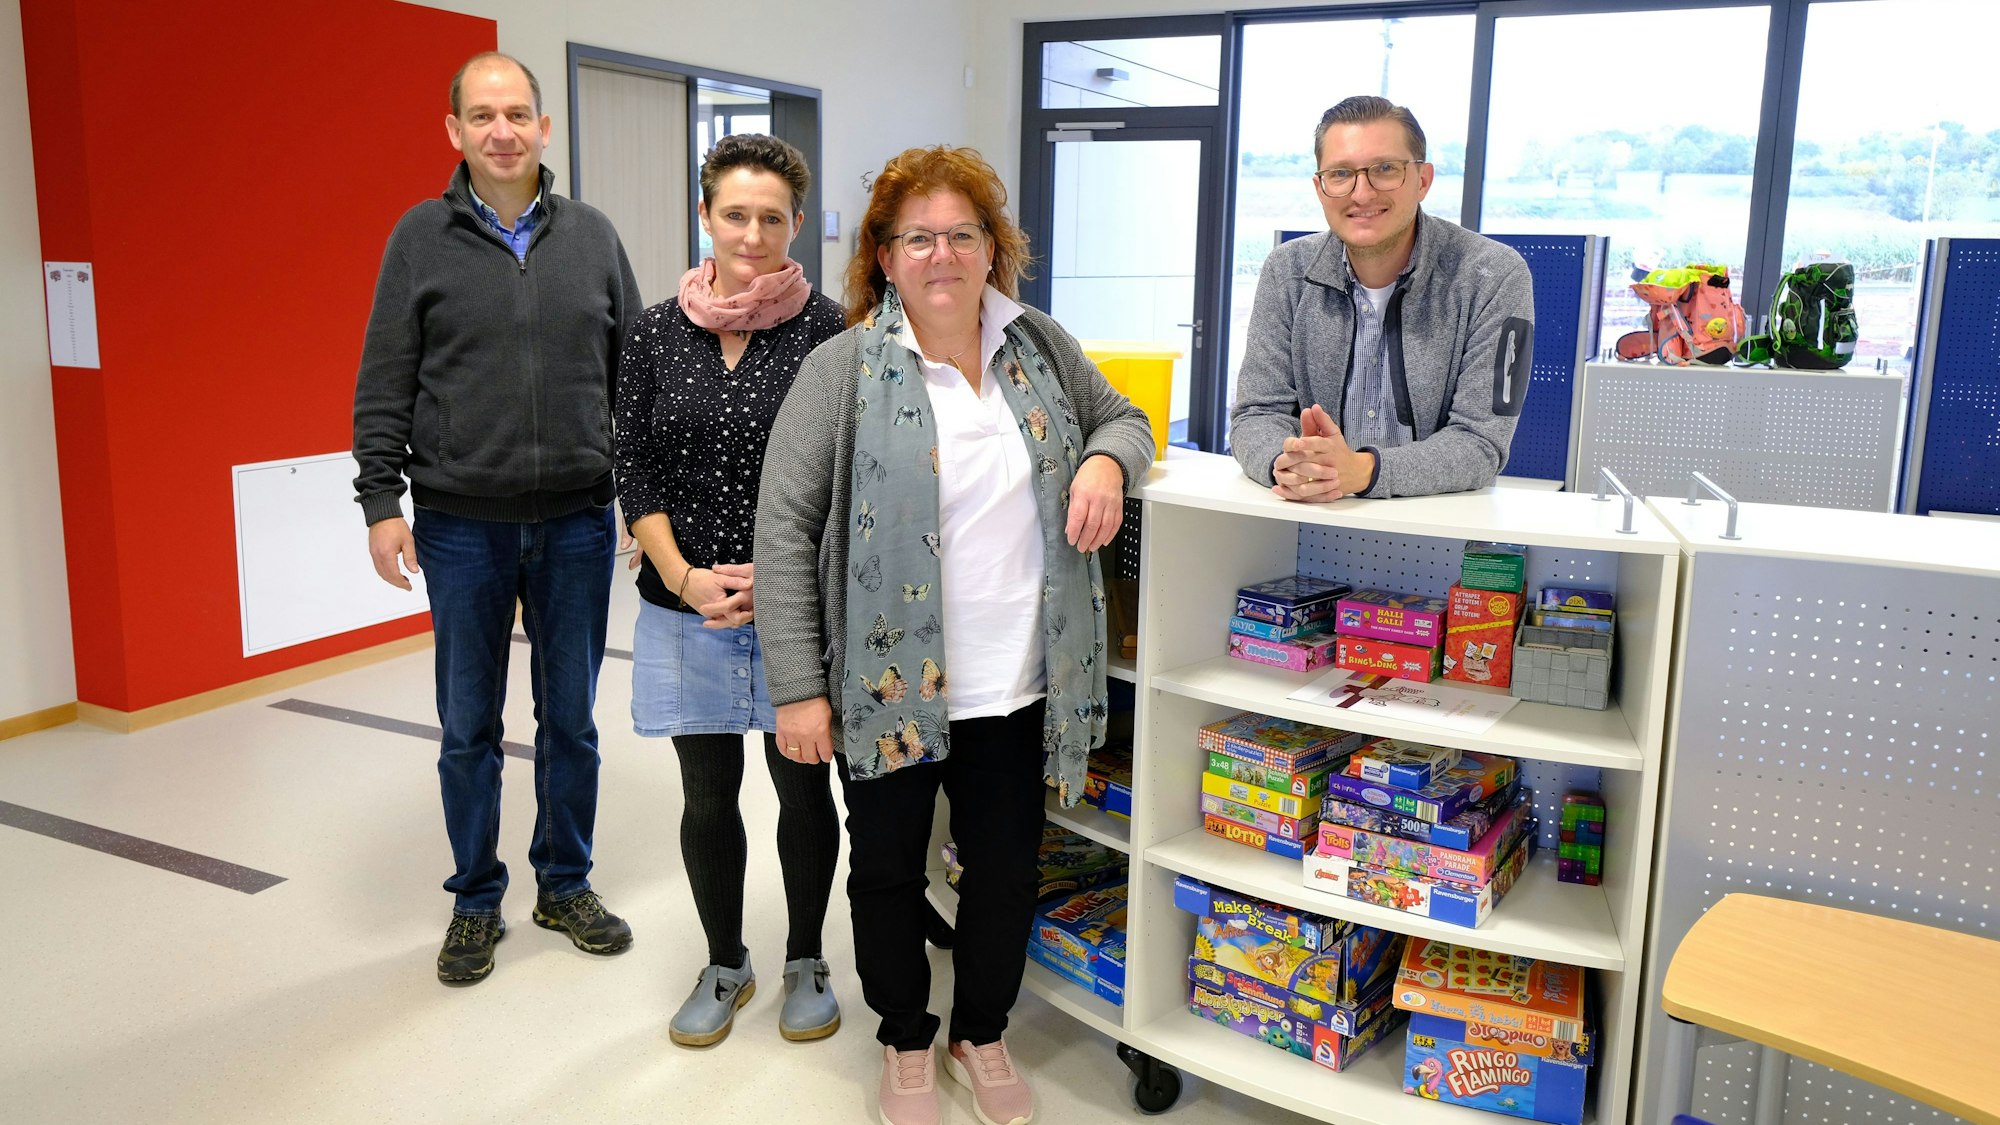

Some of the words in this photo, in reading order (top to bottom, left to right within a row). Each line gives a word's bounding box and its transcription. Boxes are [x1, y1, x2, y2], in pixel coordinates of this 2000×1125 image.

[1568, 597, 1584, 605] pixi
[1377, 609, 1404, 619] HALLI
[1377, 616, 1403, 627] GALLI
[1231, 620, 1256, 632] SKYJO
[1245, 643, 1288, 663] memo
[1254, 798, 1271, 808] Puzzle
[1401, 818, 1420, 832] 500
[1433, 823, 1466, 835] Ravensburger
[1225, 824, 1264, 847] LOTTO
[1268, 834, 1302, 849] Ravensburger
[1322, 831, 1350, 849] Trolls
[1440, 851, 1476, 866] PANORAMA
[1444, 861, 1471, 872] PARADE
[1444, 869, 1476, 881] Clementoni
[1175, 881, 1208, 896] Ravensburger
[1433, 888, 1475, 904] Ravensburger
[1405, 892, 1415, 901] 60
[1213, 901, 1252, 914] Make
[1247, 913, 1292, 944] Break
[1226, 972, 1264, 992] Spiele
[1236, 982, 1286, 1008] Sammlung
[1431, 999, 1467, 1018] Hurra,
[1451, 1050, 1517, 1074] RINGO
[1541, 1056, 1585, 1070] Ravensburger
[1448, 1067, 1530, 1096] FLAMINGO
